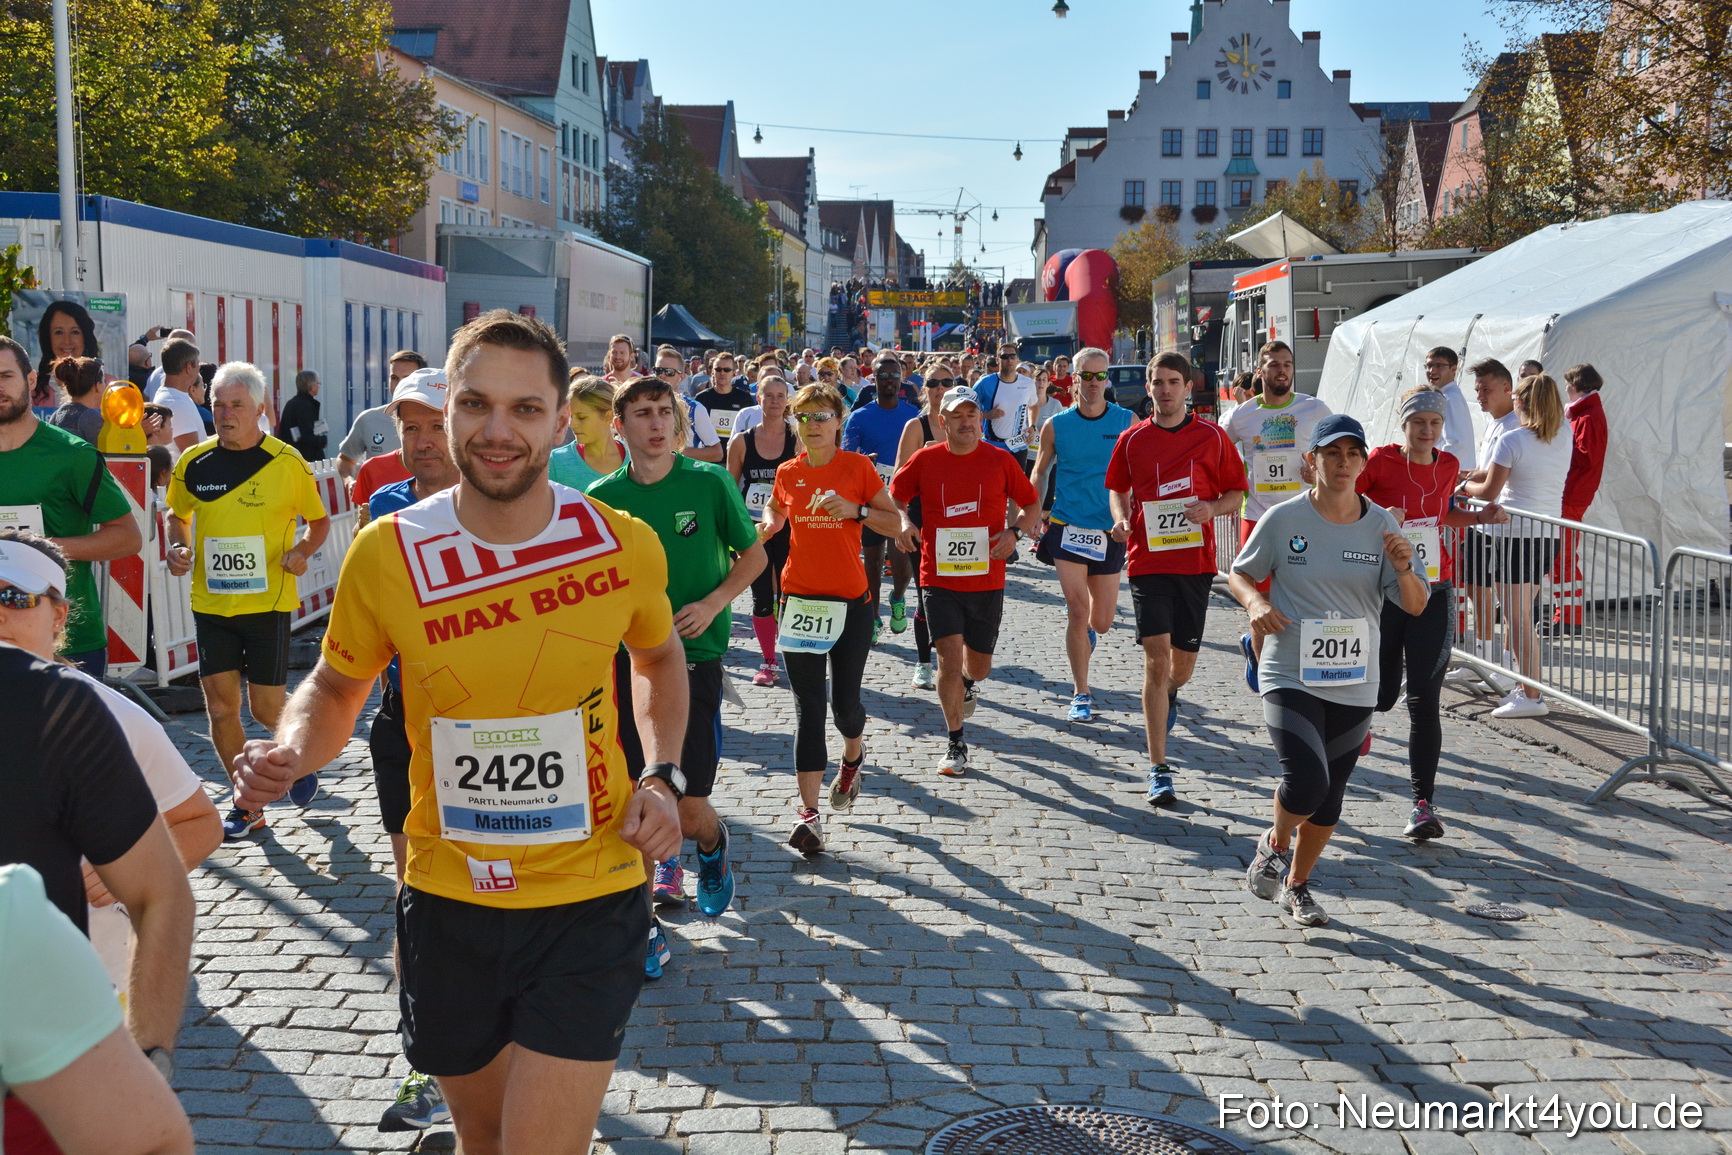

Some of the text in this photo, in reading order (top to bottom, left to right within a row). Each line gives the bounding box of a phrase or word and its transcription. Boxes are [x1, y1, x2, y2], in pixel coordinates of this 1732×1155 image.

[899, 294, 934, 303] START
[719, 418, 729, 426] 83
[1269, 464, 1284, 478] 91
[196, 484, 227, 492] Norbert
[1167, 482, 1182, 491] DEHN
[237, 497, 265, 507] Burgthann
[795, 514, 836, 523] funrunners
[1157, 512, 1188, 529] 272
[1069, 533, 1102, 545] 2356
[1162, 535, 1189, 545] Dominik
[948, 541, 976, 556] 267
[212, 552, 256, 571] 2063
[1343, 550, 1379, 563] BOCK
[423, 566, 630, 645] MAX BÖGL
[791, 613, 833, 634] 2511
[800, 640, 817, 648] Gabi
[1312, 638, 1361, 658] 2014
[1321, 670, 1352, 679] Martina
[473, 728, 541, 744] BOCK
[455, 751, 564, 792] 2426
[468, 796, 544, 806] PARTL Neumarkt
[475, 813, 553, 830] Matthias
